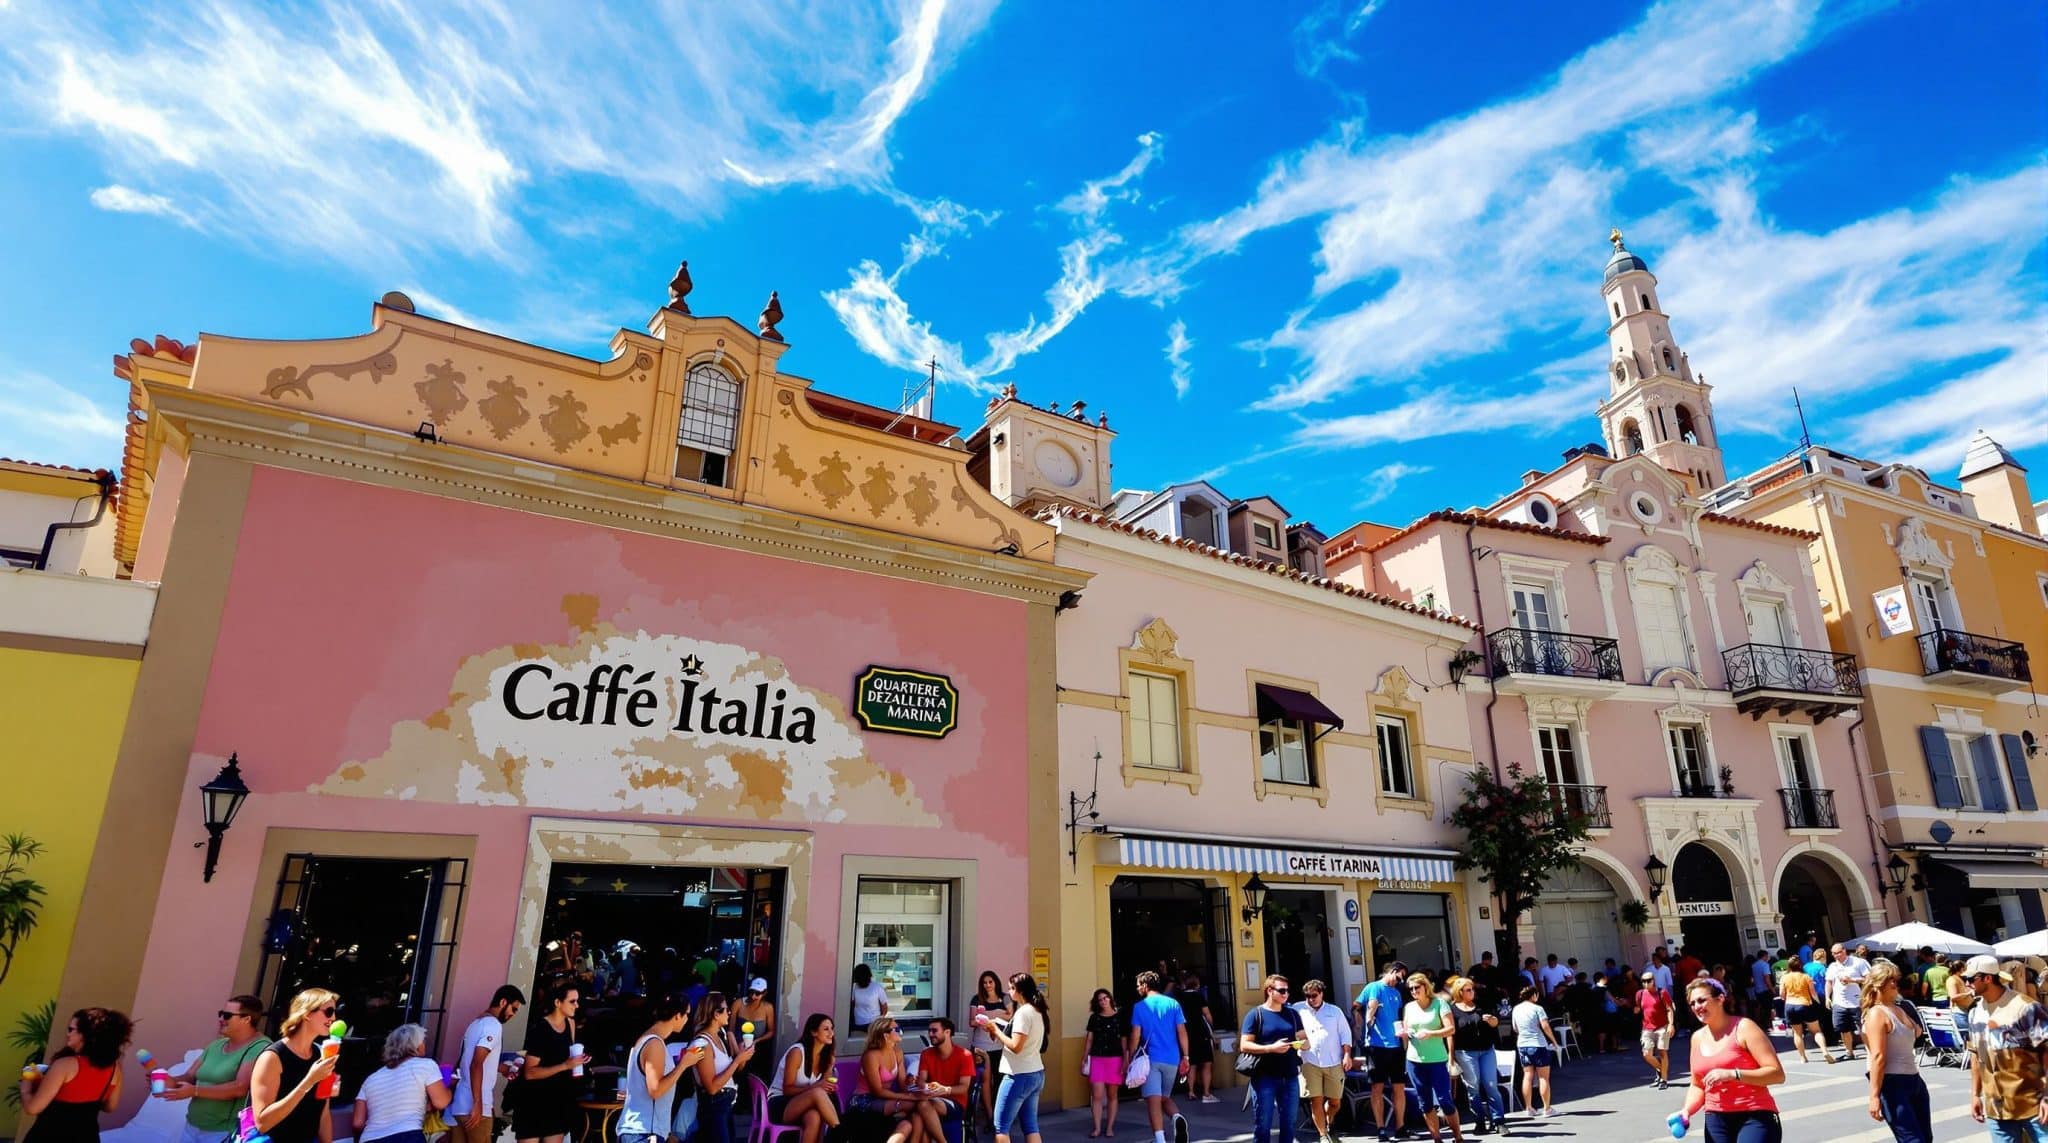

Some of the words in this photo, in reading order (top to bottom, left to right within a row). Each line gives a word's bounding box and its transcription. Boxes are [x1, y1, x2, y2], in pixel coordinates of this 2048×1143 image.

[873, 677, 940, 698] QUARTIERE
[502, 663, 658, 728] Caffé
[672, 679, 817, 745] Italia
[887, 704, 942, 724] MARINA
[1289, 855, 1327, 872] CAFFÉ
[1330, 859, 1381, 874] ITARINA
